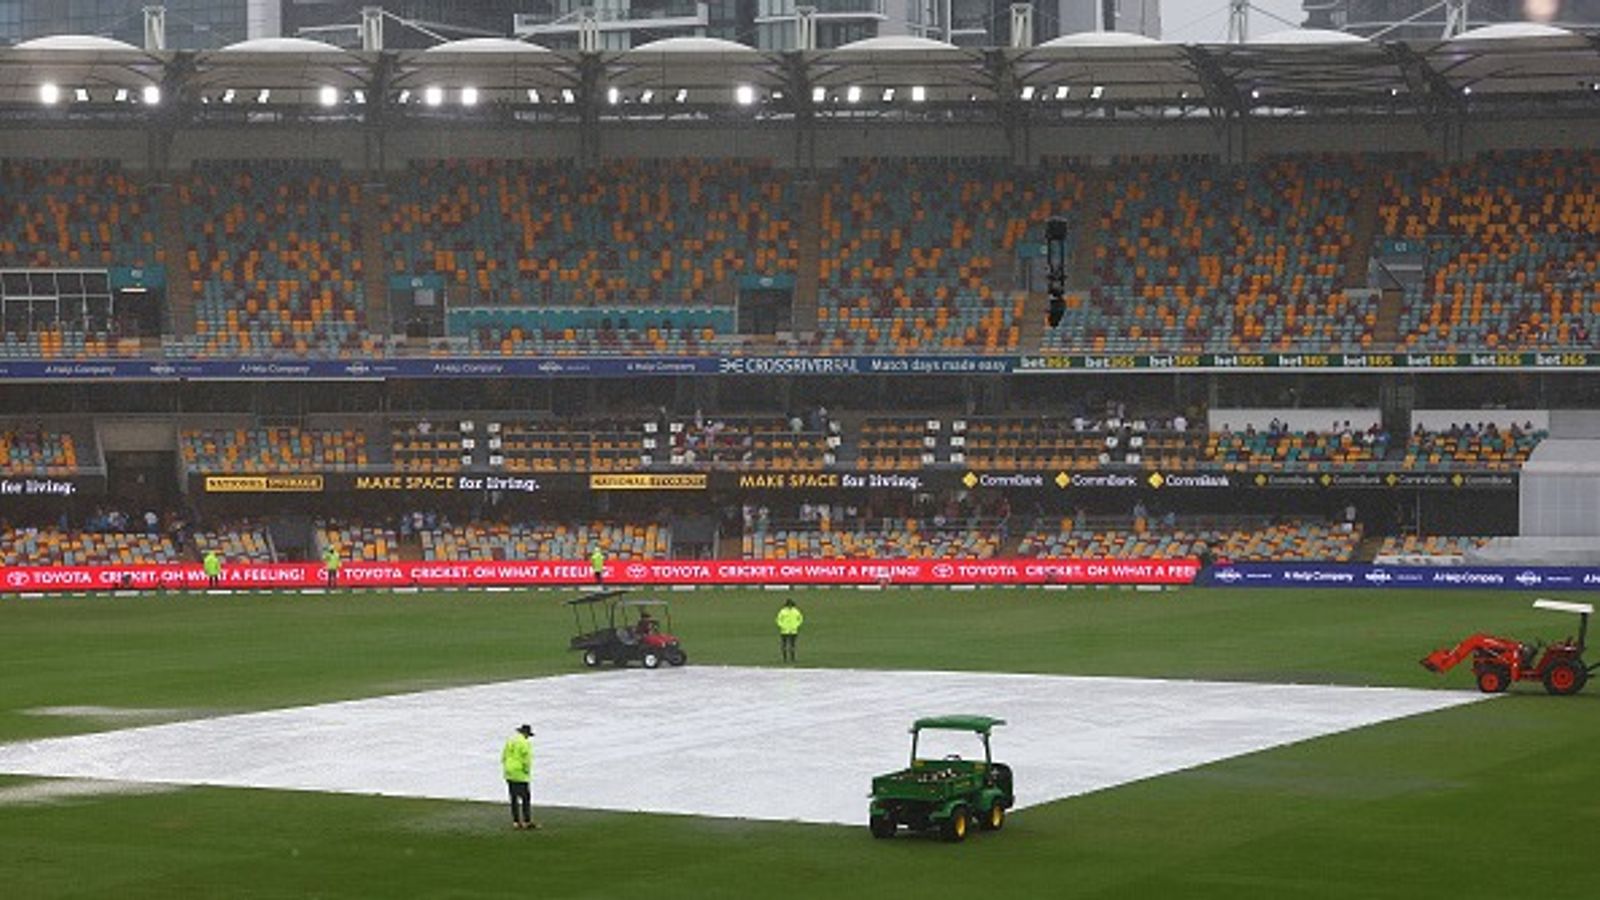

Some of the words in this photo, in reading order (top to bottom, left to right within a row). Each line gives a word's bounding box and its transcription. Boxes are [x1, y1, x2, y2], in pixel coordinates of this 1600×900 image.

[872, 359, 908, 371] Match
[910, 359, 940, 373] days
[942, 359, 975, 371] made
[977, 360, 1007, 373] easy
[356, 476, 402, 490] MAKE
[406, 476, 454, 490] SPACE
[459, 476, 482, 490] for
[486, 476, 540, 492] living.
[740, 474, 784, 487] MAKE
[788, 474, 838, 488] SPACE
[842, 474, 866, 486] for
[869, 474, 922, 490] living.
[980, 474, 1043, 487] CommBank
[1072, 474, 1137, 487] CommBank
[1166, 474, 1230, 487] CommBank
[1, 480, 22, 494] for
[26, 479, 76, 496] living.
[34, 571, 92, 583] TOYOTA
[161, 570, 183, 582] OH
[187, 568, 227, 582] WHT
[231, 568, 242, 580] A
[244, 568, 305, 580] FEELING!
[344, 568, 403, 580] TOYOTA
[411, 566, 471, 578] CRICKET.
[474, 566, 496, 578] OH
[498, 566, 538, 578] WHAT
[540, 566, 550, 578] A
[652, 566, 710, 578] TOYOTA
[718, 566, 777, 578] CRICKET.
[780, 566, 801, 577] OH
[804, 566, 845, 577] WHAT
[848, 566, 858, 577] A
[861, 566, 920, 578] FEELING!
[958, 566, 1018, 578] TOYOTA
[1026, 566, 1084, 578] CRICKET.
[1088, 566, 1109, 577] OH
[1112, 566, 1151, 577] WHAT
[1154, 566, 1165, 577] A
[1314, 572, 1354, 582] Company
[1463, 572, 1504, 583] Company
